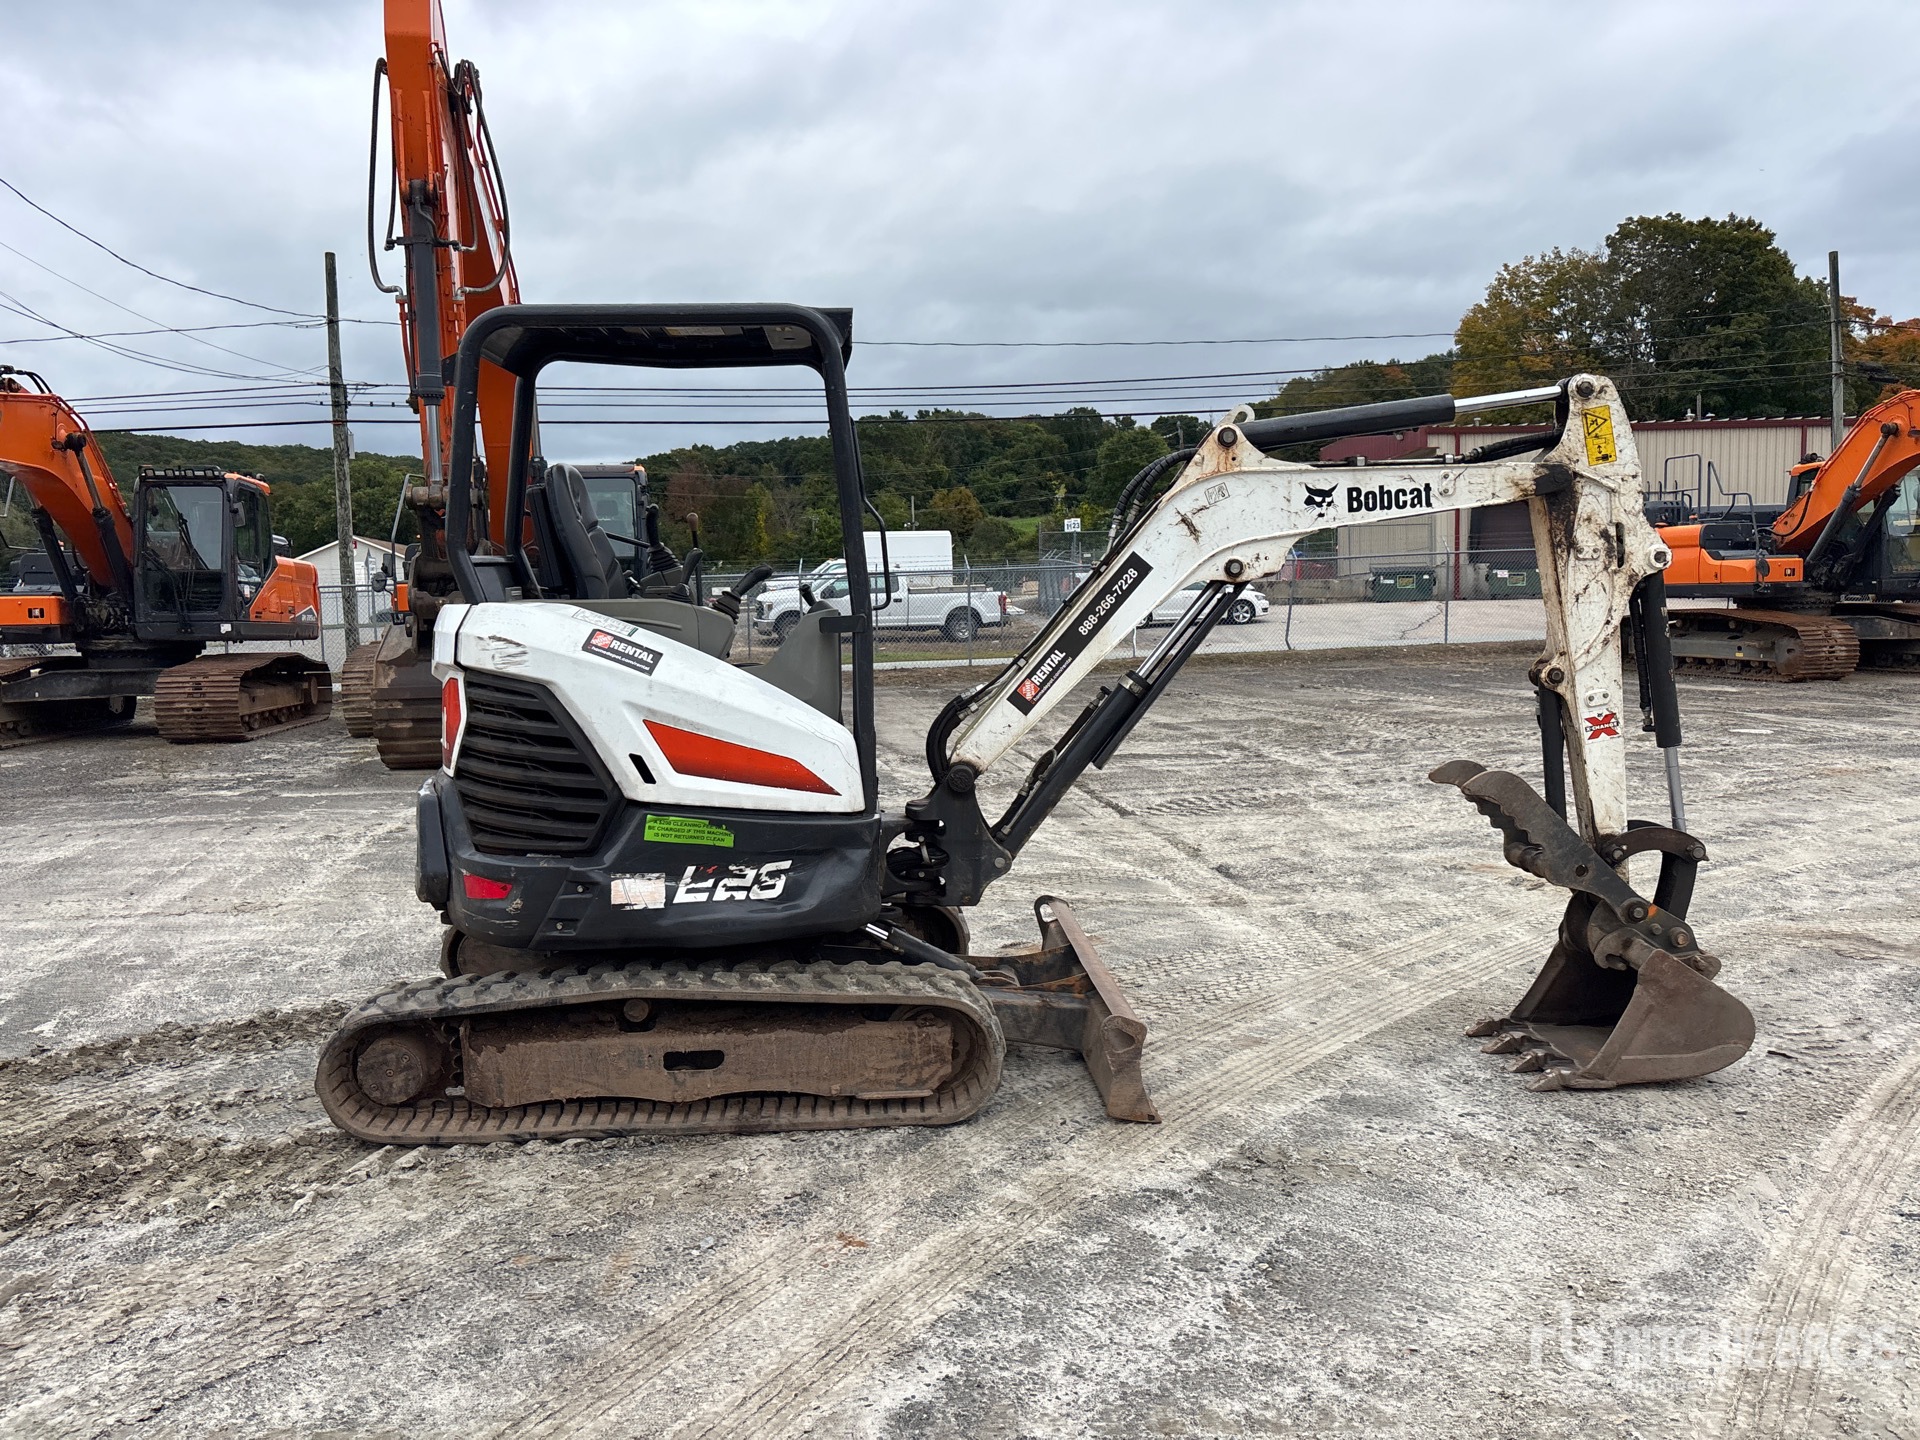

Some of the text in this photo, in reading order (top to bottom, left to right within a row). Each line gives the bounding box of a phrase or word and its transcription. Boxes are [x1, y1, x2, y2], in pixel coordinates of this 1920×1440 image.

[1347, 483, 1432, 513] Bobcat
[1078, 568, 1138, 636] 888-266-7228
[592, 646, 650, 671] homedepot.com/rental
[610, 639, 654, 664] RENTAL
[1031, 649, 1066, 686] RENTAL
[1033, 657, 1073, 701] homedepot.com/rental
[707, 830, 732, 838] MACHINE
